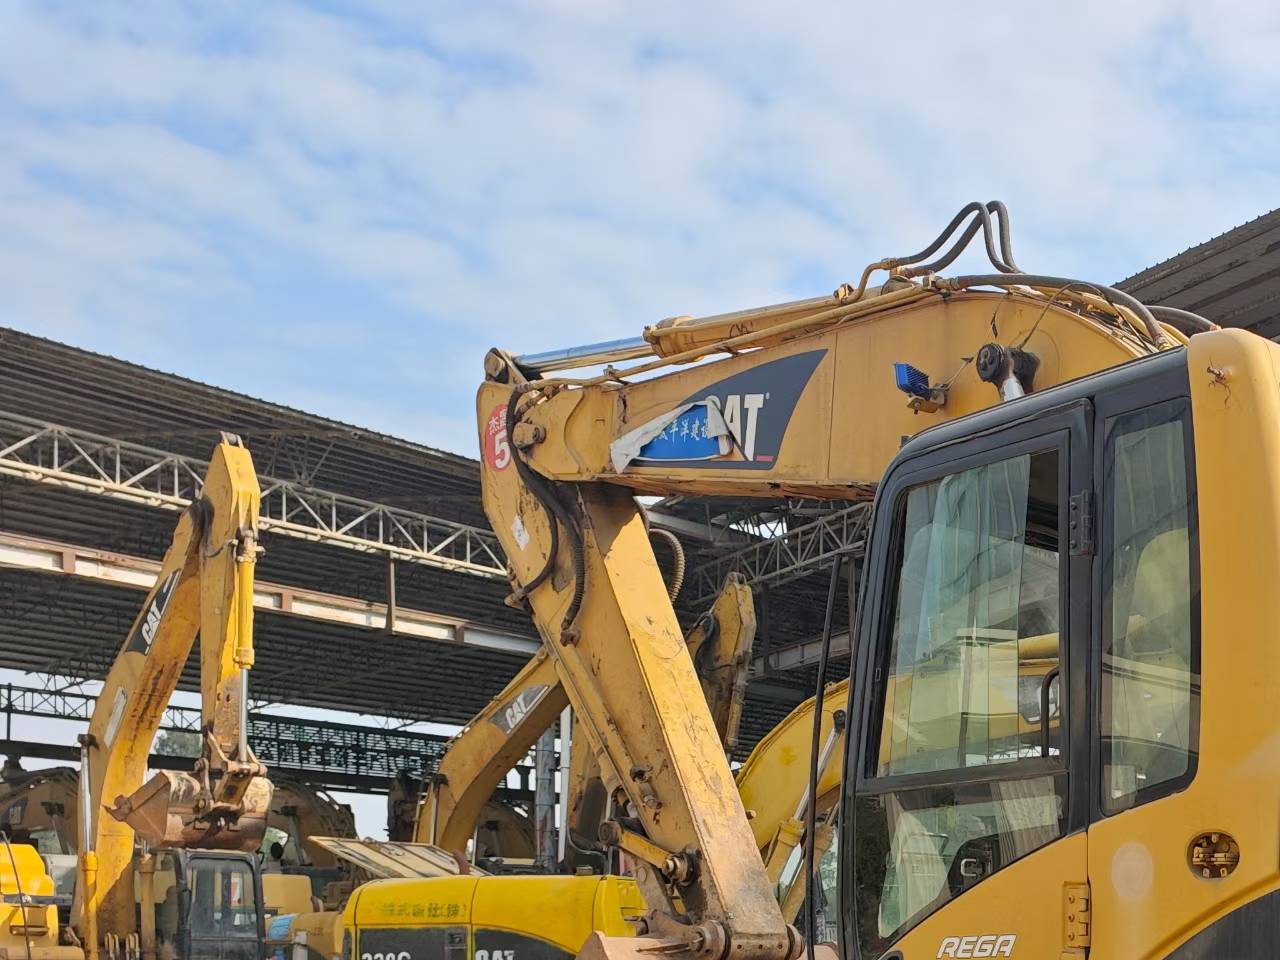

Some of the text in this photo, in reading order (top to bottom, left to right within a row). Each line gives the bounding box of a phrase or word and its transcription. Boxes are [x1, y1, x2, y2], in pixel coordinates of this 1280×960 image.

[705, 394, 764, 461] AT
[495, 430, 511, 468] 5
[141, 598, 162, 645] CAT
[936, 934, 1017, 959] REGA
